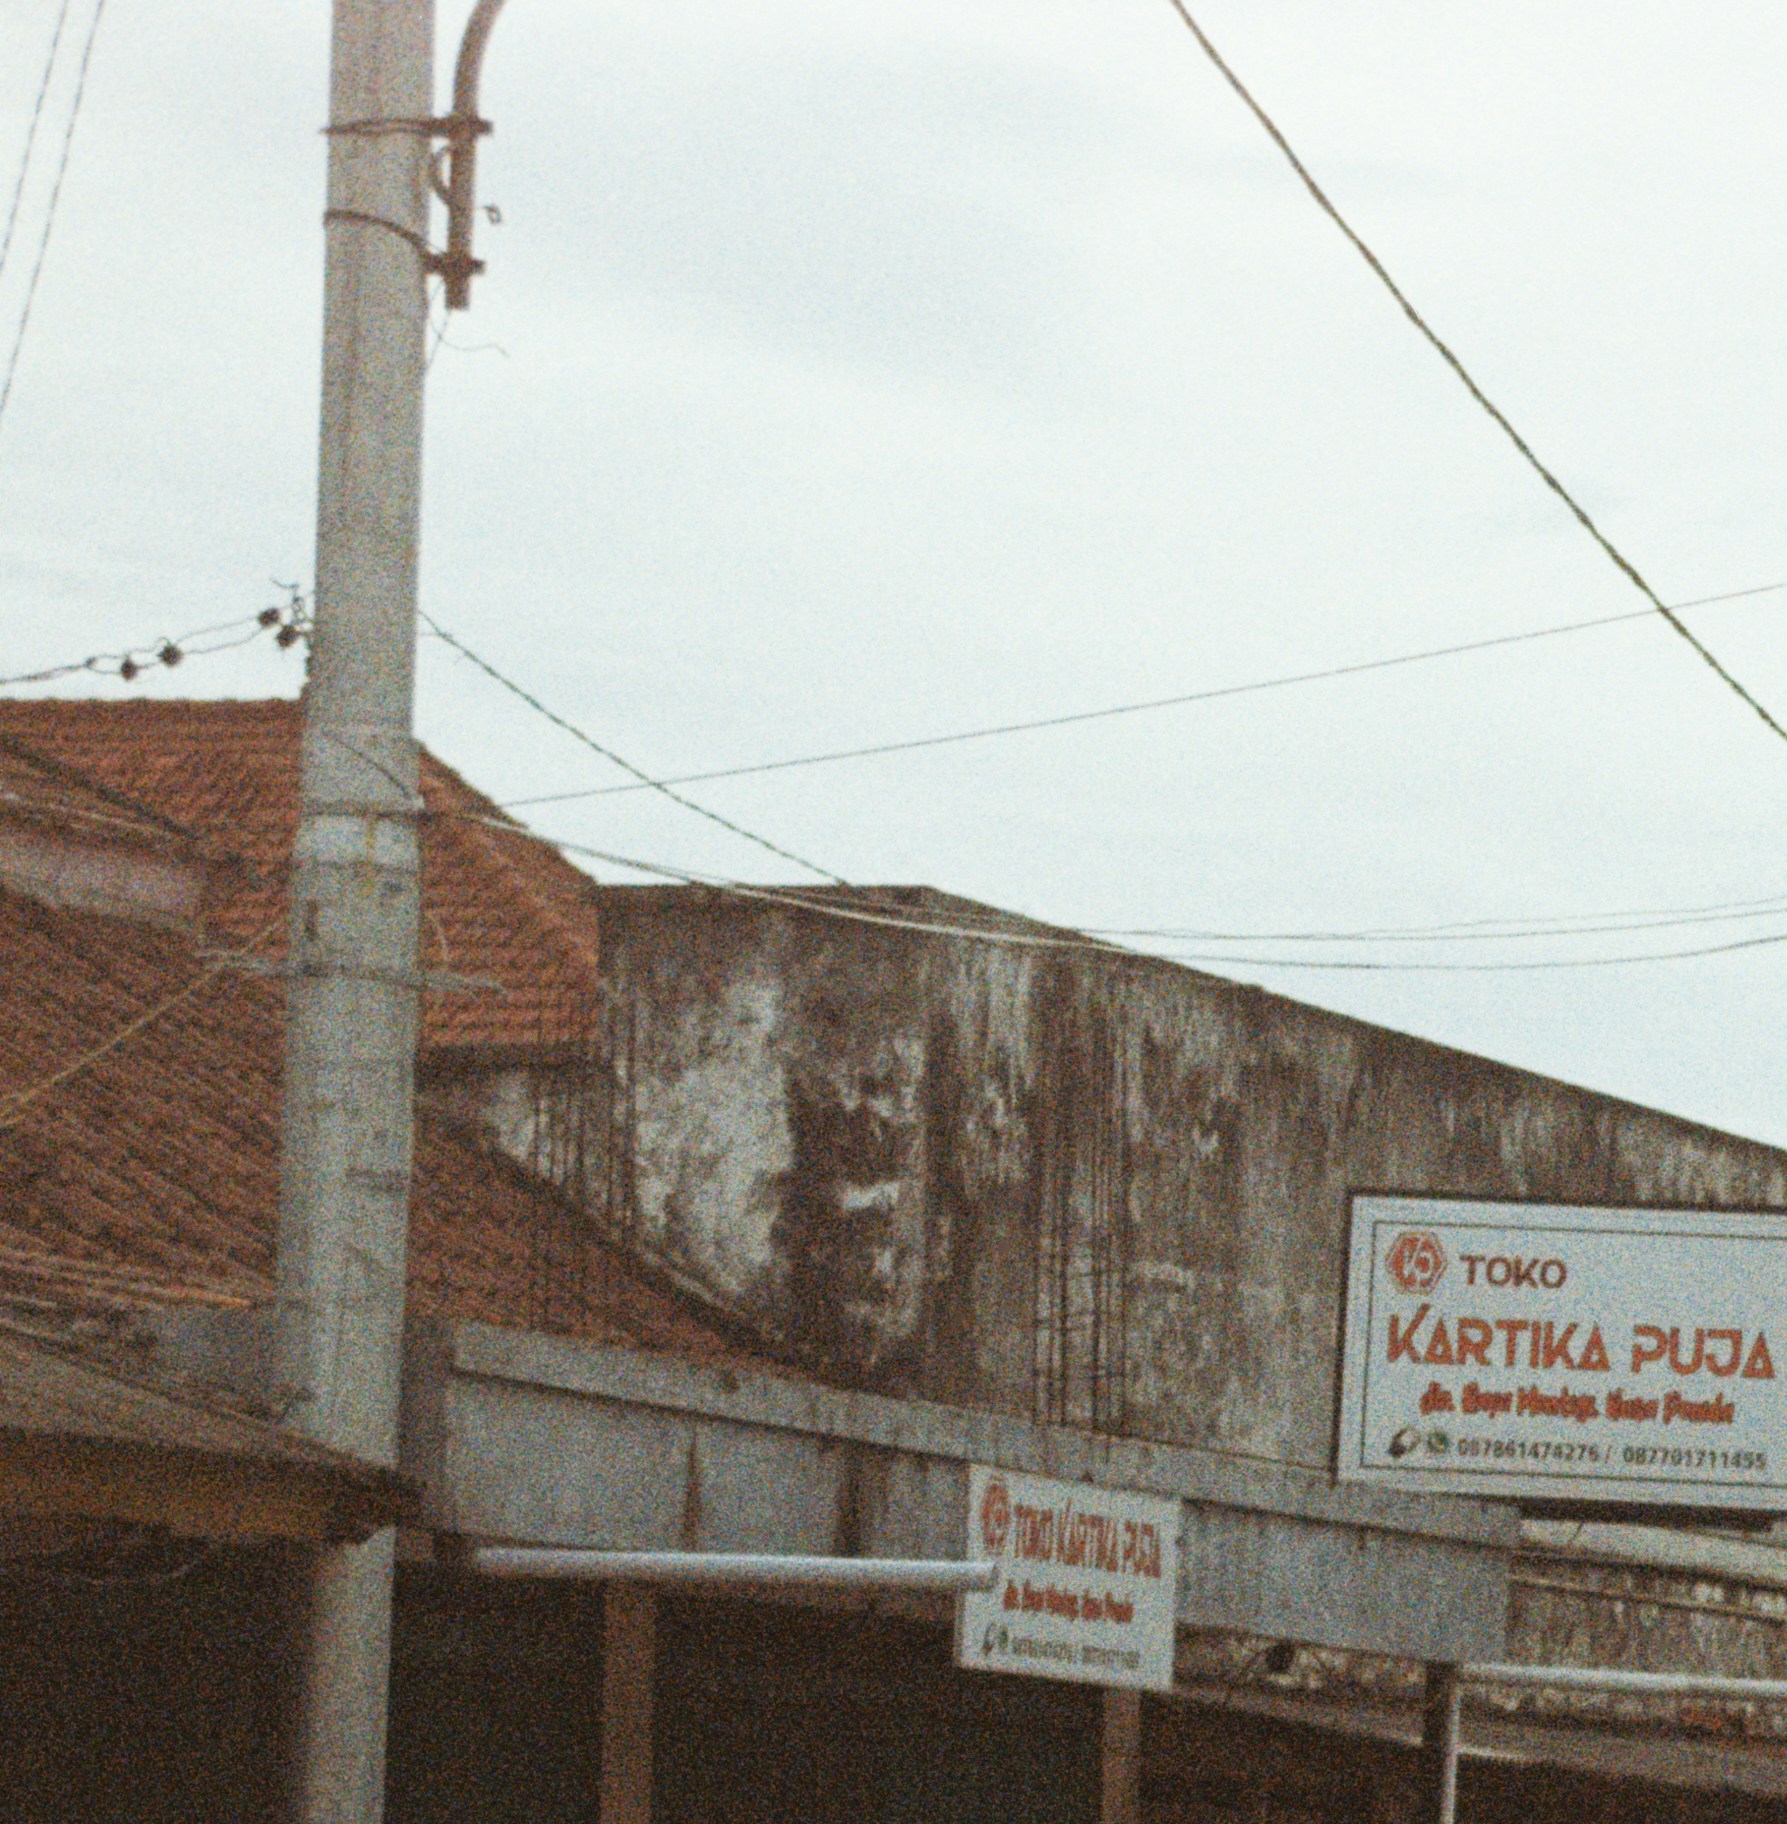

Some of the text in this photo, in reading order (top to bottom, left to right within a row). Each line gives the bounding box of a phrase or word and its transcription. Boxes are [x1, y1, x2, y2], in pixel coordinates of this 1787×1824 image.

[1459, 1254, 1568, 1290] TOKO
[1387, 1302, 1776, 1380] KARTIKA PUJA
